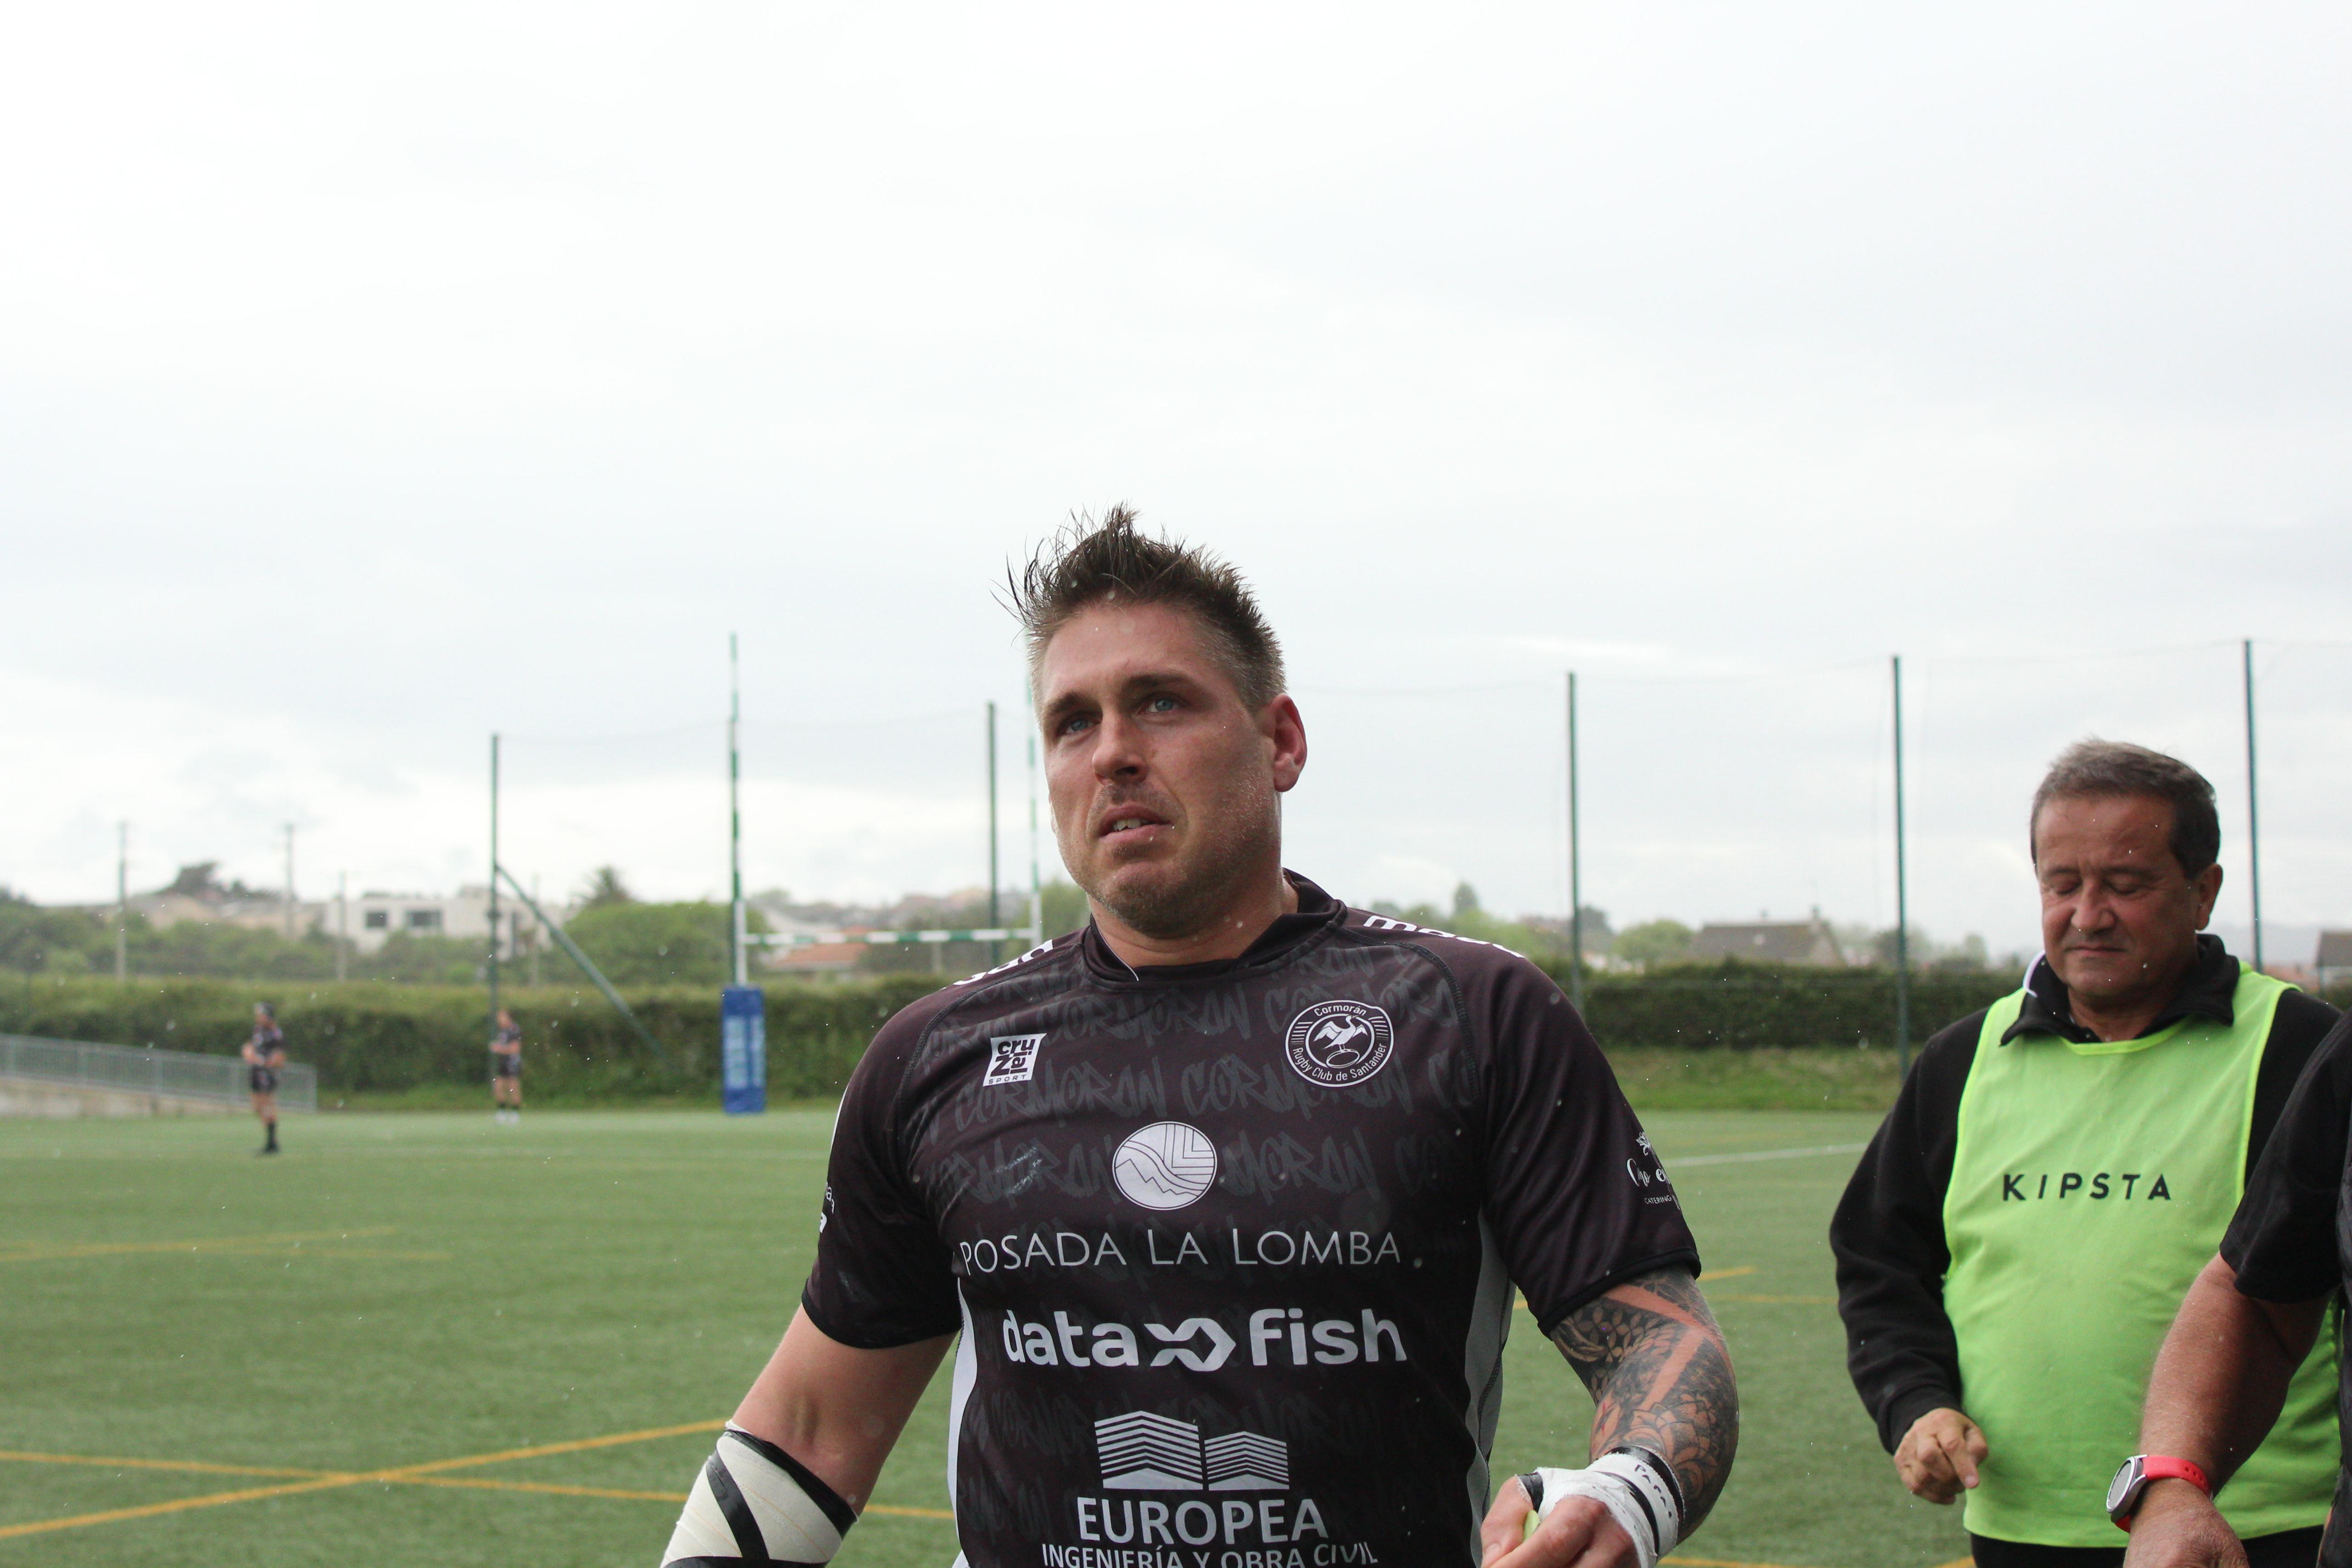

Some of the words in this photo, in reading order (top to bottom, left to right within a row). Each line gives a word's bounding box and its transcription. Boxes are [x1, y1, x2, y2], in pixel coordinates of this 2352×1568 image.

[1314, 1005, 1367, 1017] Cormorán
[1292, 1047, 1312, 1073] Rugby
[1312, 1067, 1333, 1081] Club
[1336, 1071, 1348, 1081] de
[1350, 1043, 1387, 1079] Santander
[988, 1074, 1027, 1085] SPORT
[1644, 1195, 1672, 1204] CATERING
[2003, 1172, 2171, 1201] KIPSTA
[960, 1232, 1127, 1275] POSADA
[1148, 1229, 1209, 1264] LA
[1233, 1228, 1401, 1265] LOMBA
[1002, 1309, 1139, 1367] data
[1249, 1308, 1407, 1366] fish
[1077, 1496, 1329, 1545] EUROPEA
[1042, 1543, 1183, 1568] INGENIERÍA
[1192, 1551, 1210, 1568] Y
[1221, 1548, 1302, 1568] OBRA
[1313, 1541, 1379, 1566] CIVIL
